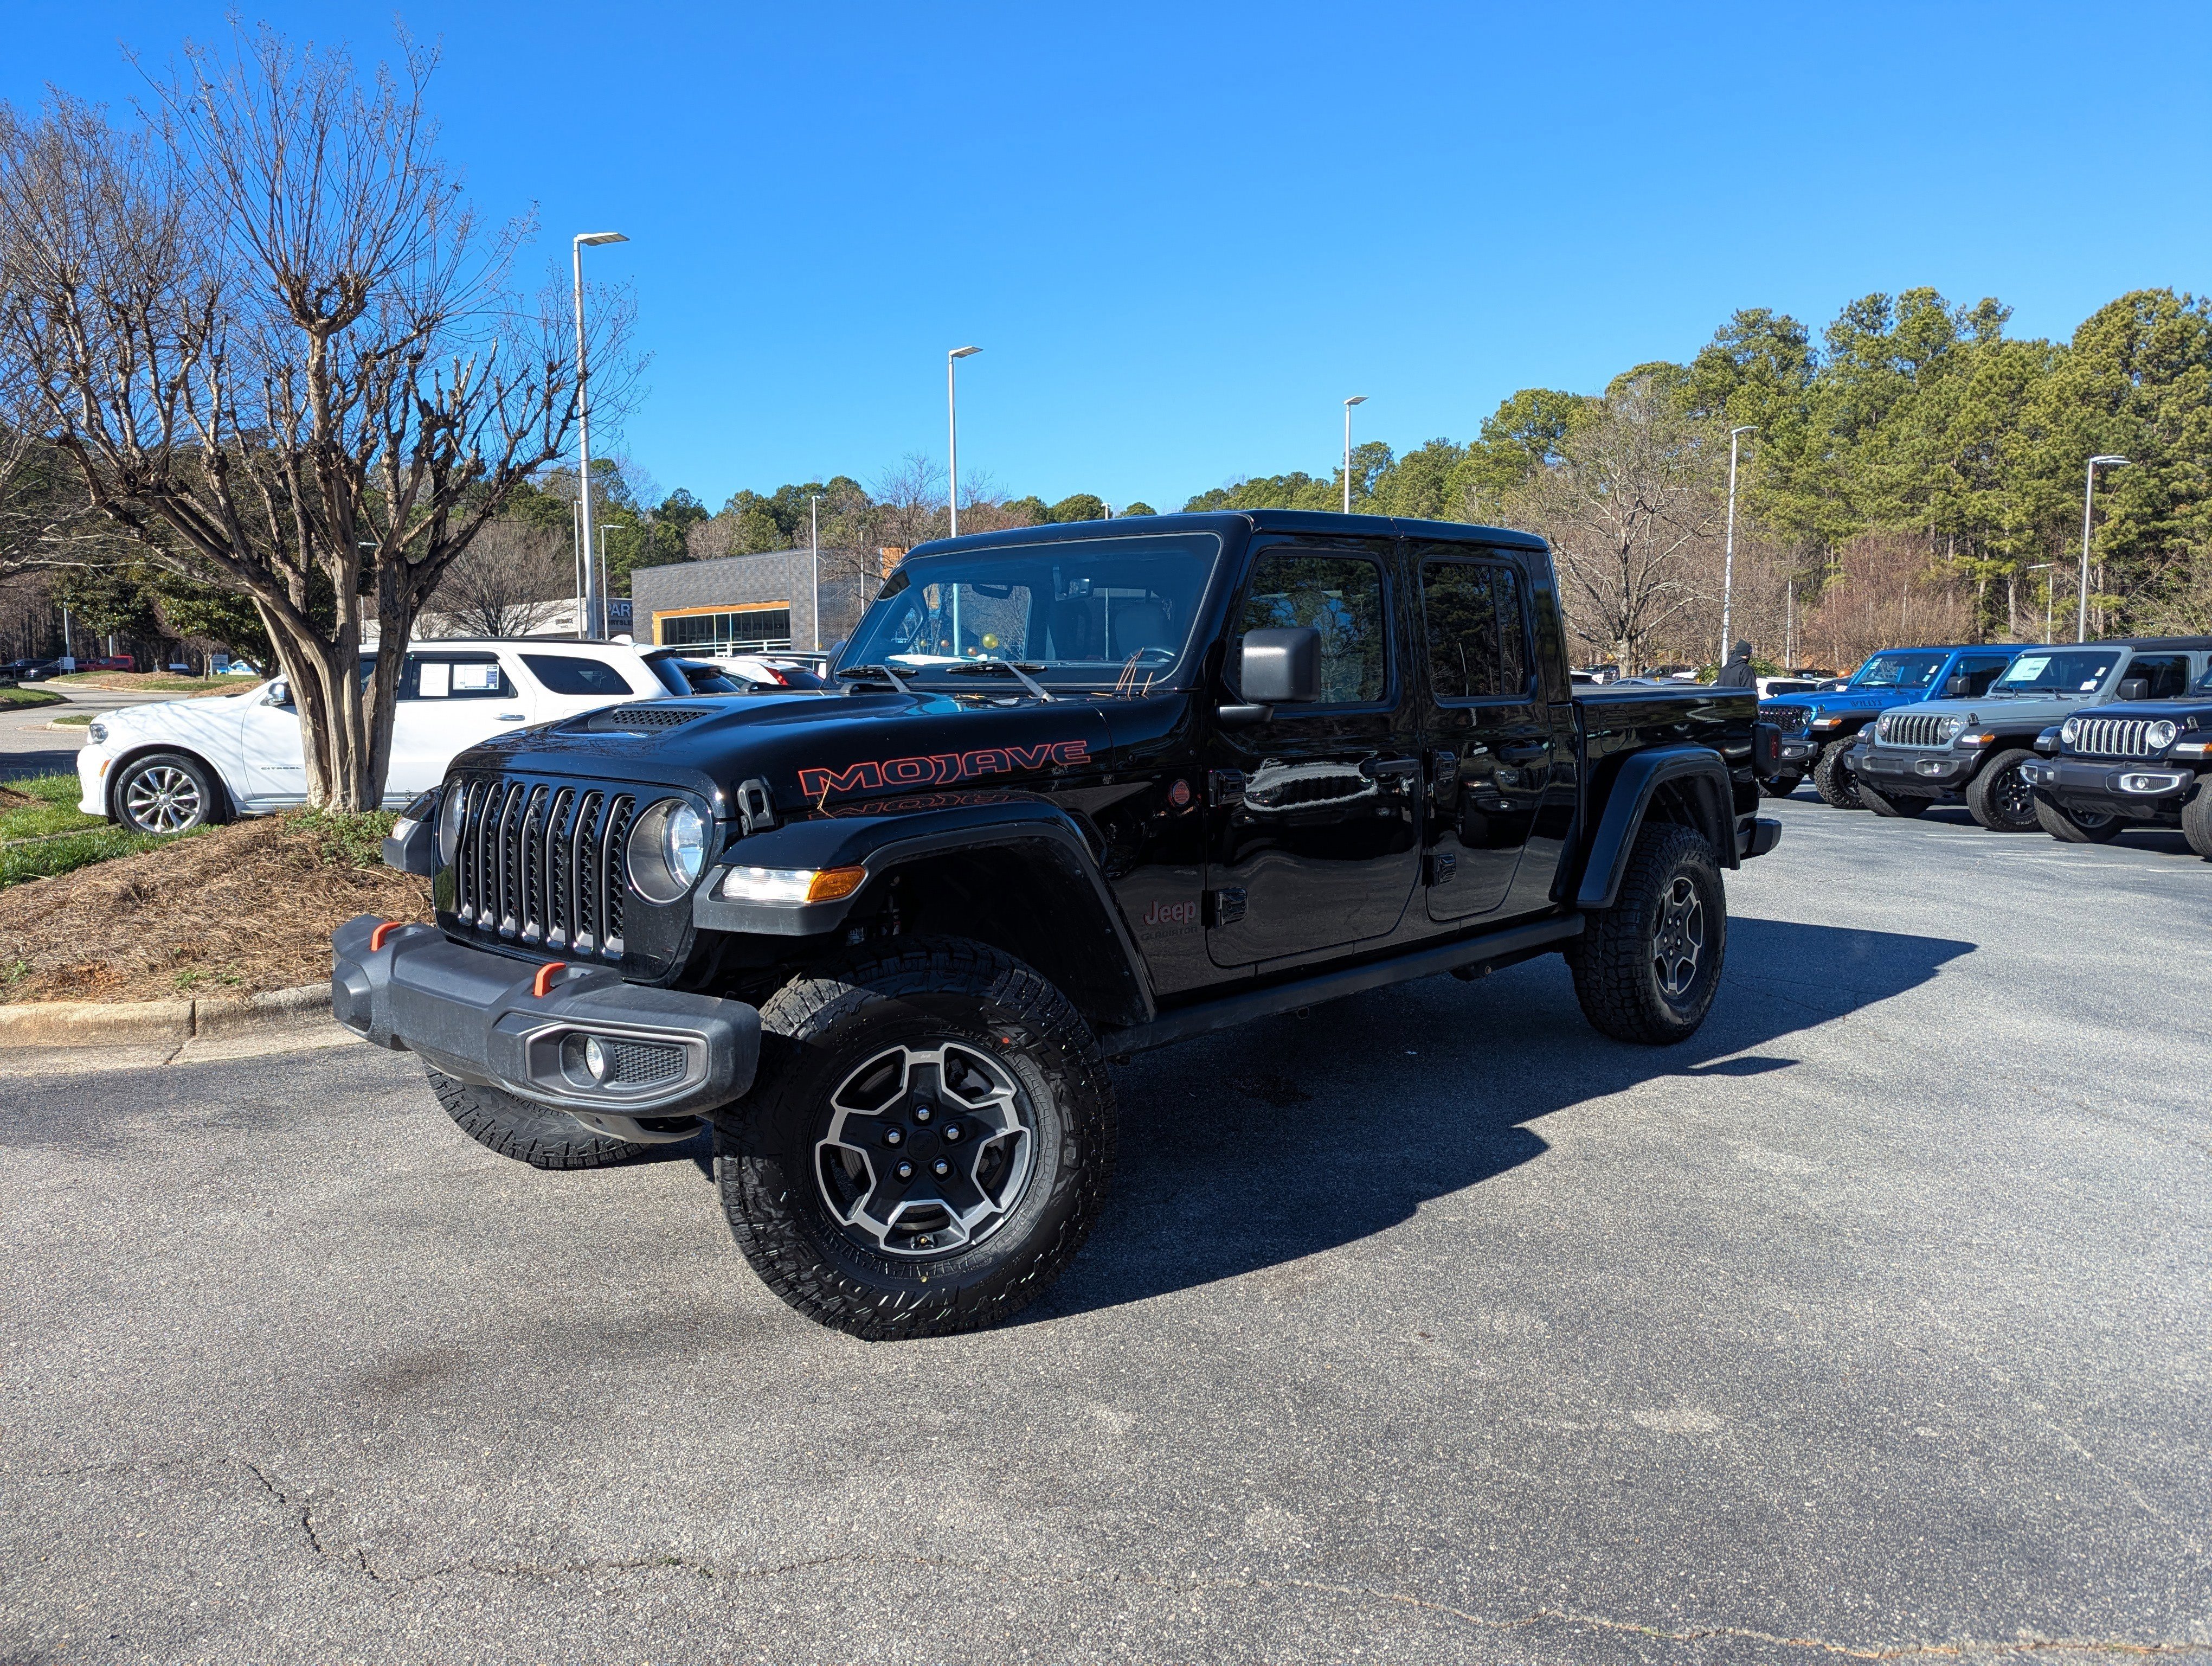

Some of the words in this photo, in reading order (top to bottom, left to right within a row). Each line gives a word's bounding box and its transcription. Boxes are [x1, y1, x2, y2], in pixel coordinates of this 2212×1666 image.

[607, 601, 633, 617] PAR
[1850, 699, 1882, 707] WILLYS
[798, 740, 1091, 796] MOJAVE
[1143, 901, 1197, 926] Jeep
[1141, 926, 1197, 941] GLADIATOR
